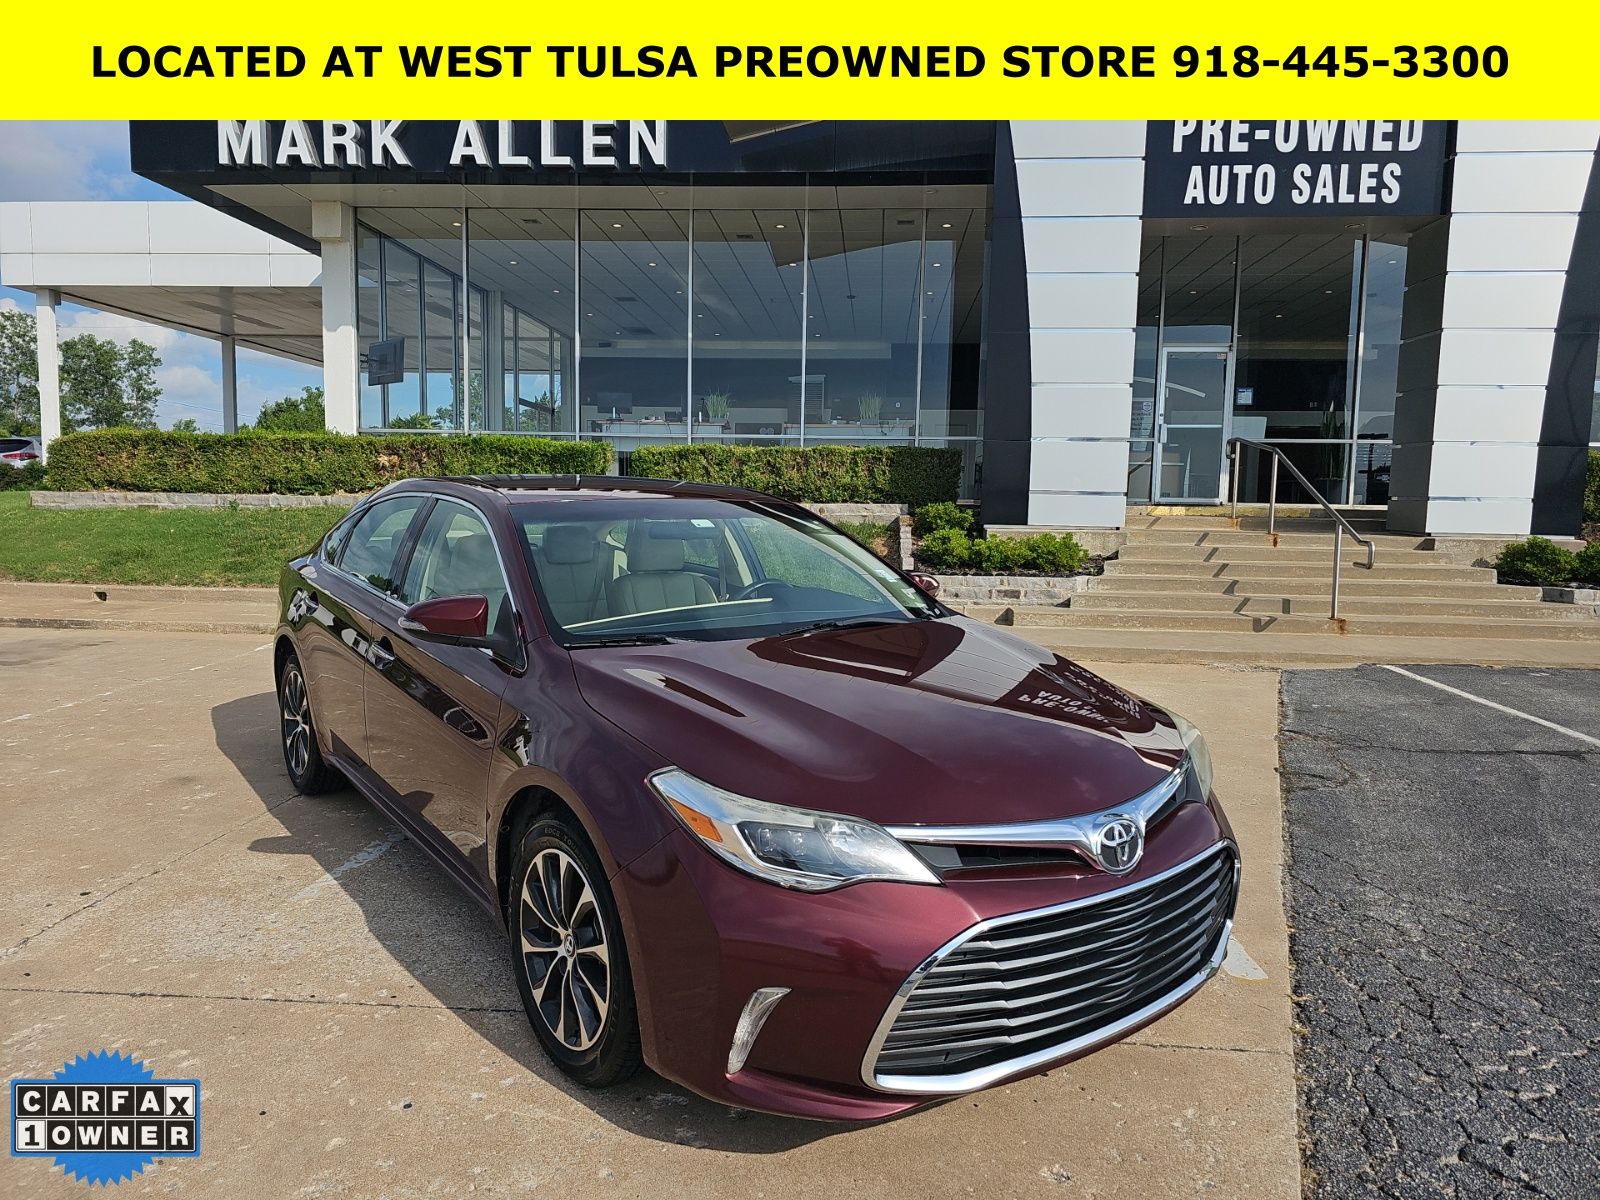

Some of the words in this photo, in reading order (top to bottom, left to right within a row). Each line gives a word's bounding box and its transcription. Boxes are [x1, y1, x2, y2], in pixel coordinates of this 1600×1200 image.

[217, 120, 413, 168] MARK
[449, 120, 668, 169] ALLEN
[1172, 120, 1424, 153] PRE-OWNED
[1183, 163, 1276, 205] AUTO
[1291, 162, 1402, 204] SALES
